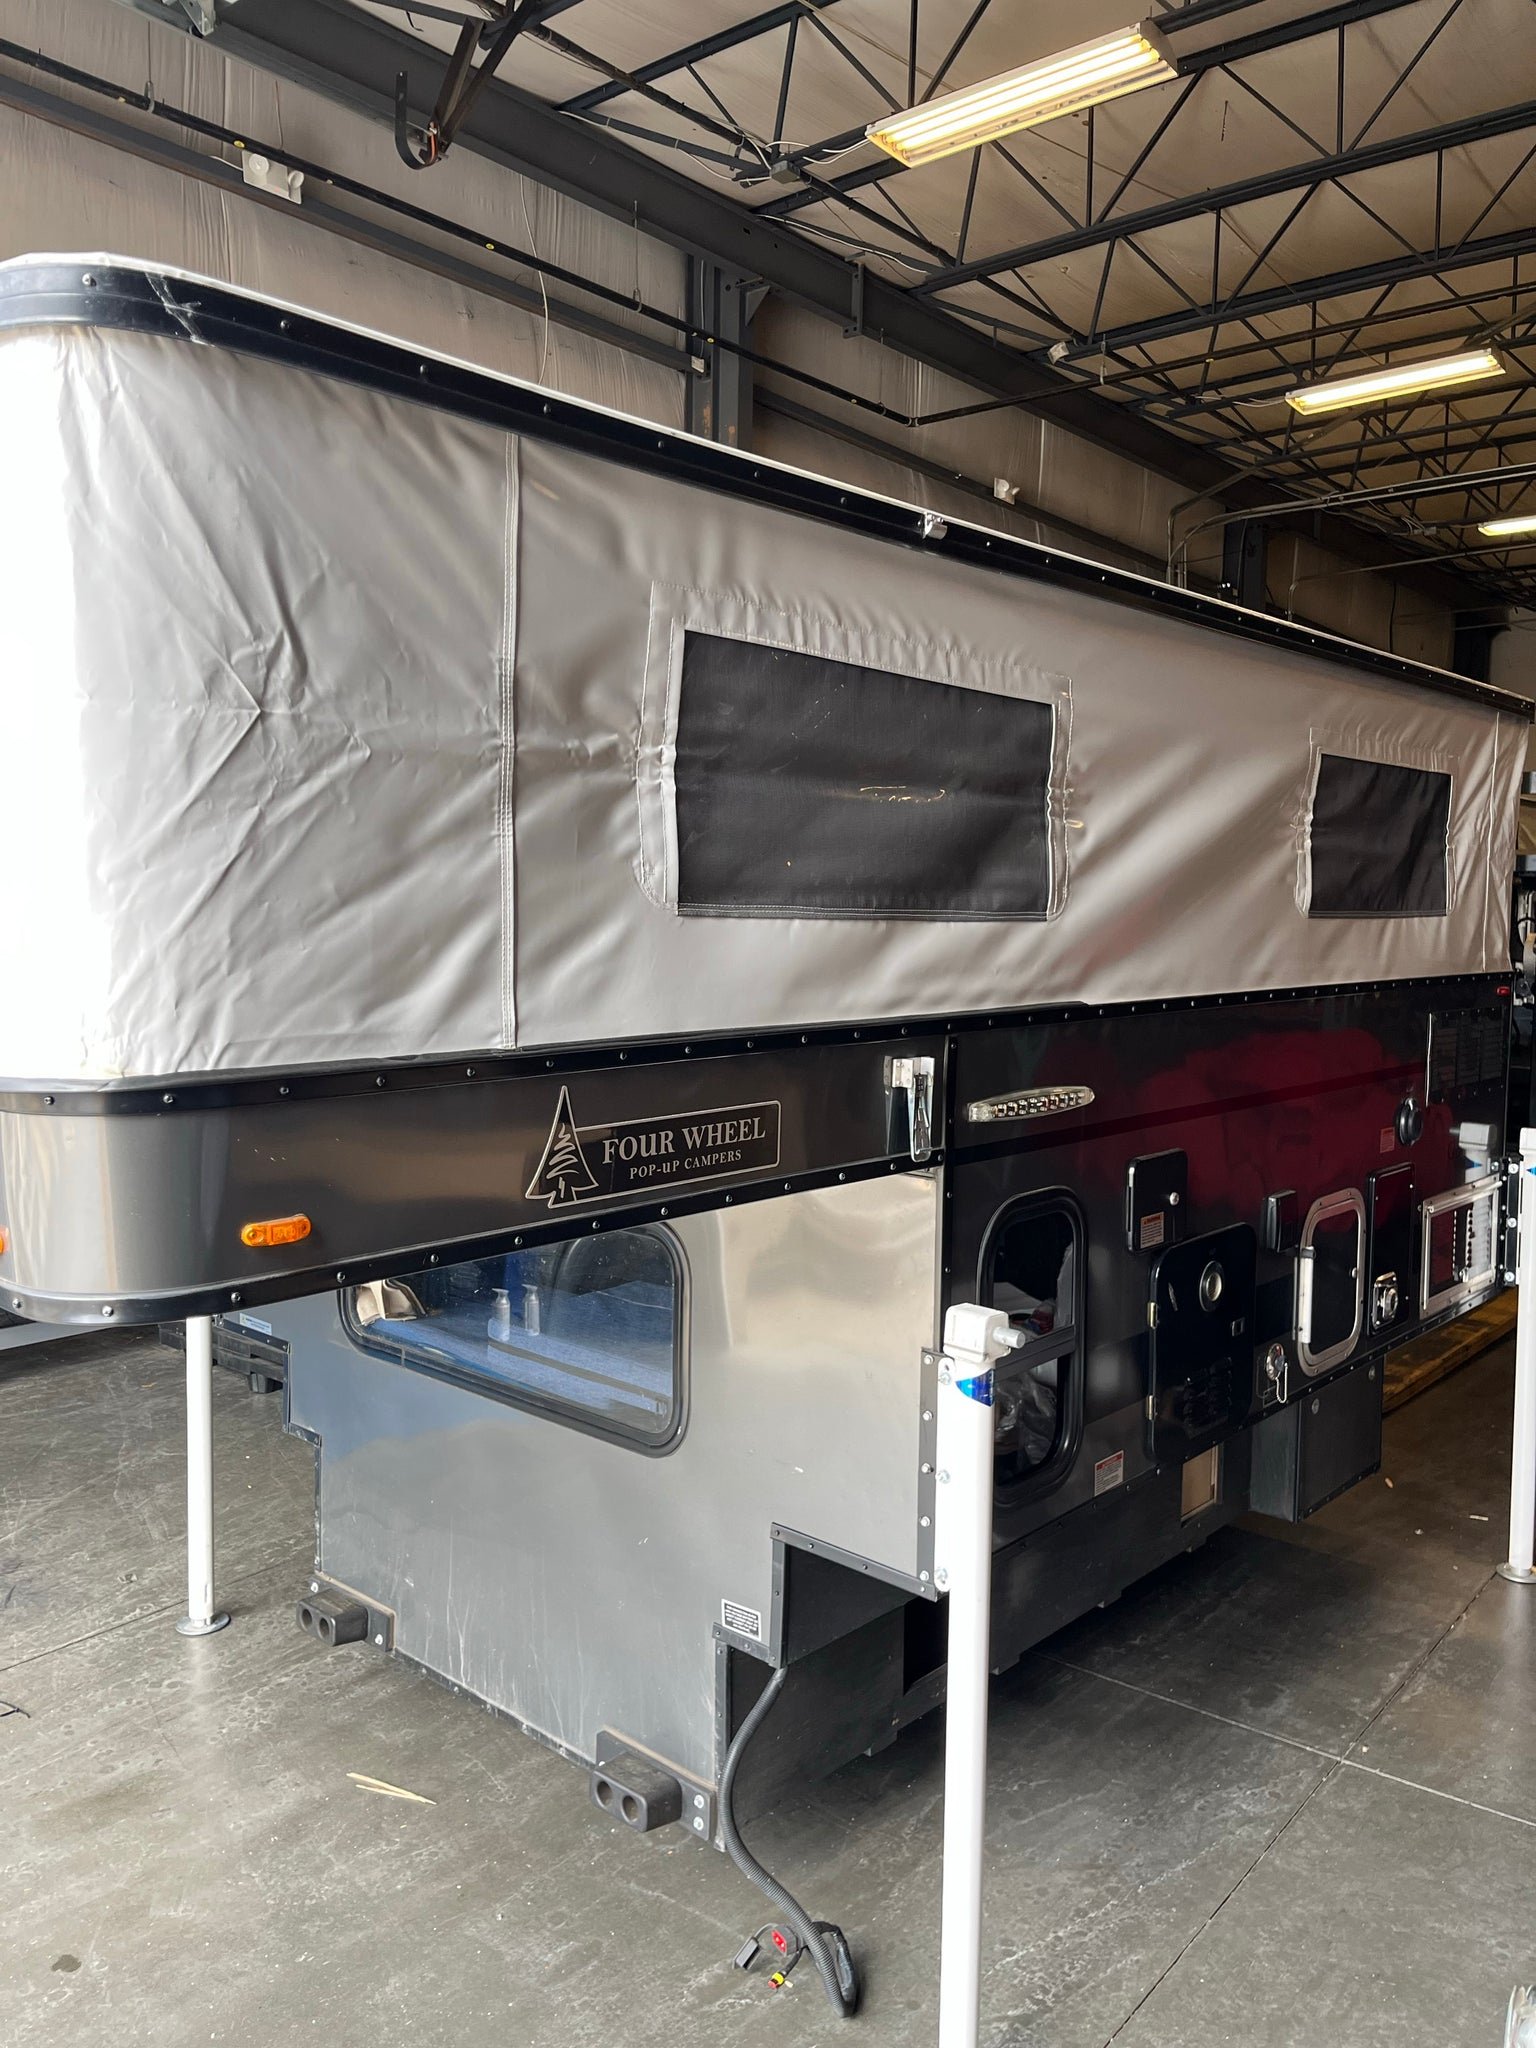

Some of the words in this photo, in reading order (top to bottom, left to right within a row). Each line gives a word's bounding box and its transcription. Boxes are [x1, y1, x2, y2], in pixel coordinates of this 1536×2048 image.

[602, 1130, 675, 1164] FOUR
[682, 1117, 766, 1150] WHEEL
[629, 1160, 680, 1180] POP-UP
[684, 1149, 742, 1170] CAMPERS
